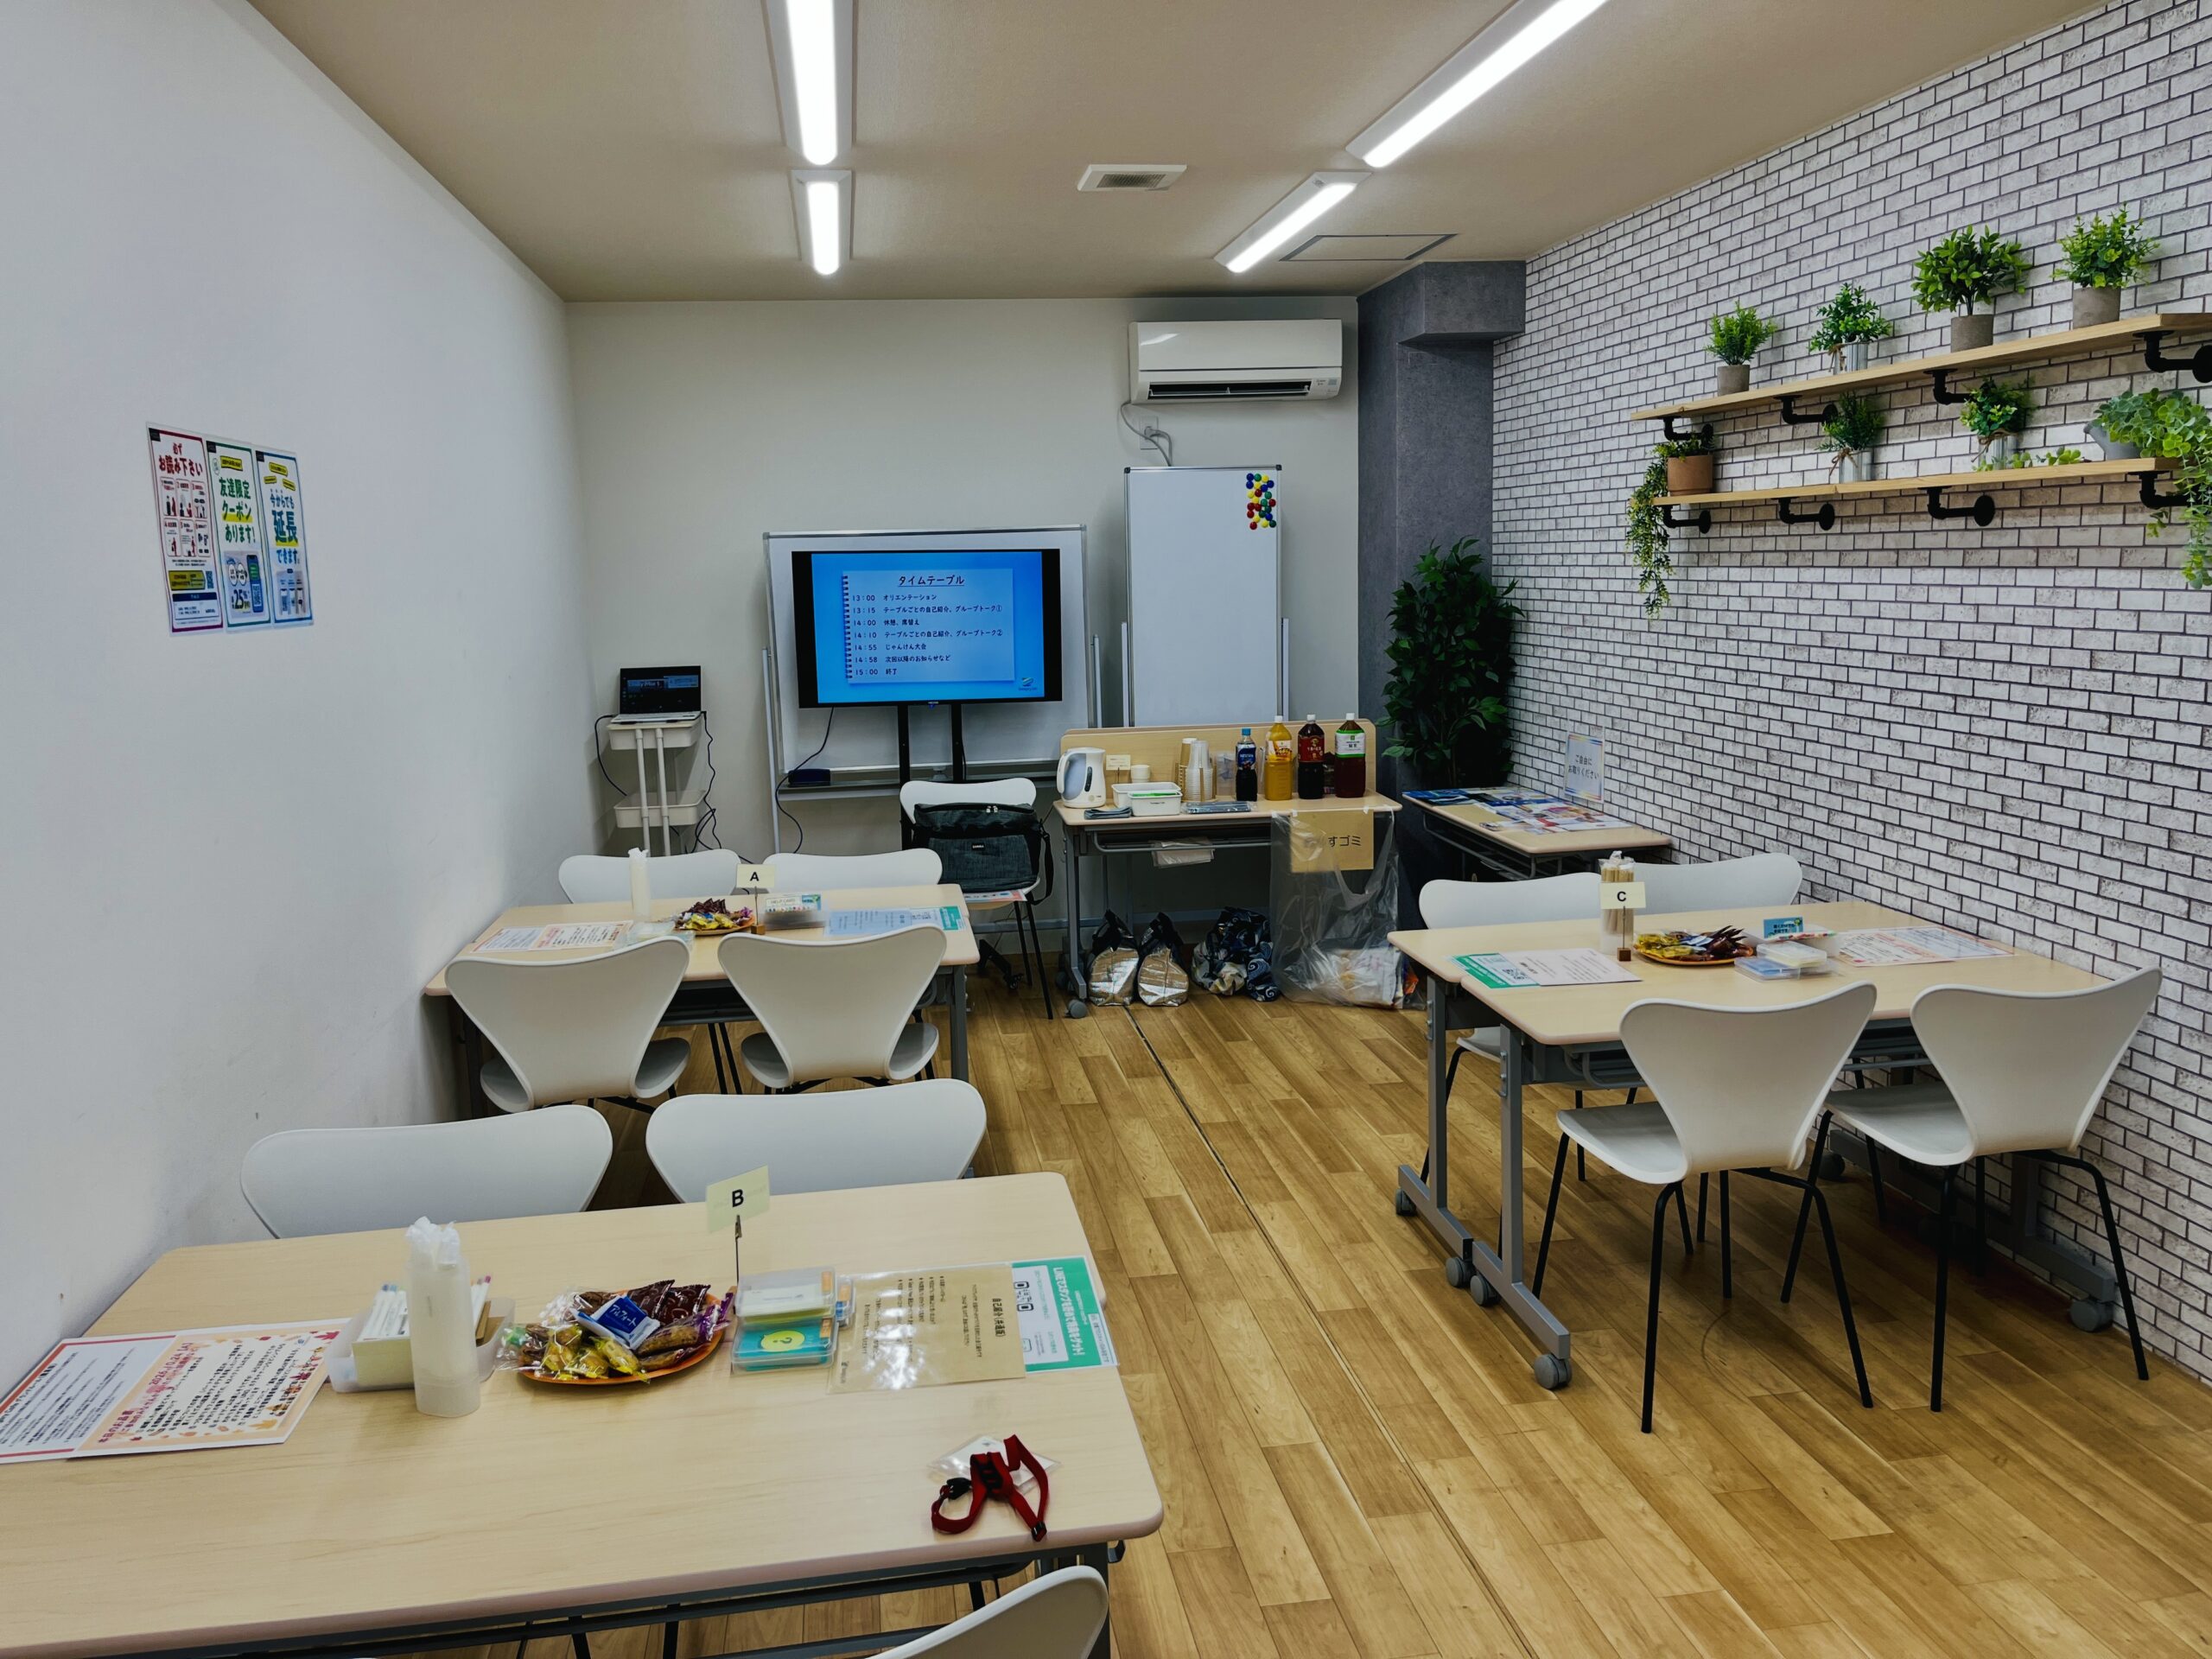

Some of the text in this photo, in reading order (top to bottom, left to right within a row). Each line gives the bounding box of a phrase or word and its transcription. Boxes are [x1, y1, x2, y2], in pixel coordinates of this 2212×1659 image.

[158, 455, 203, 477] お読み下さい
[219, 477, 251, 499] 友達限定
[222, 499, 252, 521] クーポン
[272, 511, 299, 543] 延長
[899, 575, 965, 586] タイムテーブル
[1575, 754, 1592, 766] ご自由に
[1568, 765, 1599, 779] お取りください
[749, 871, 760, 881] A
[1617, 891, 1626, 901] C
[732, 1189, 745, 1208] B
[608, 1304, 638, 1327] アルフォート
